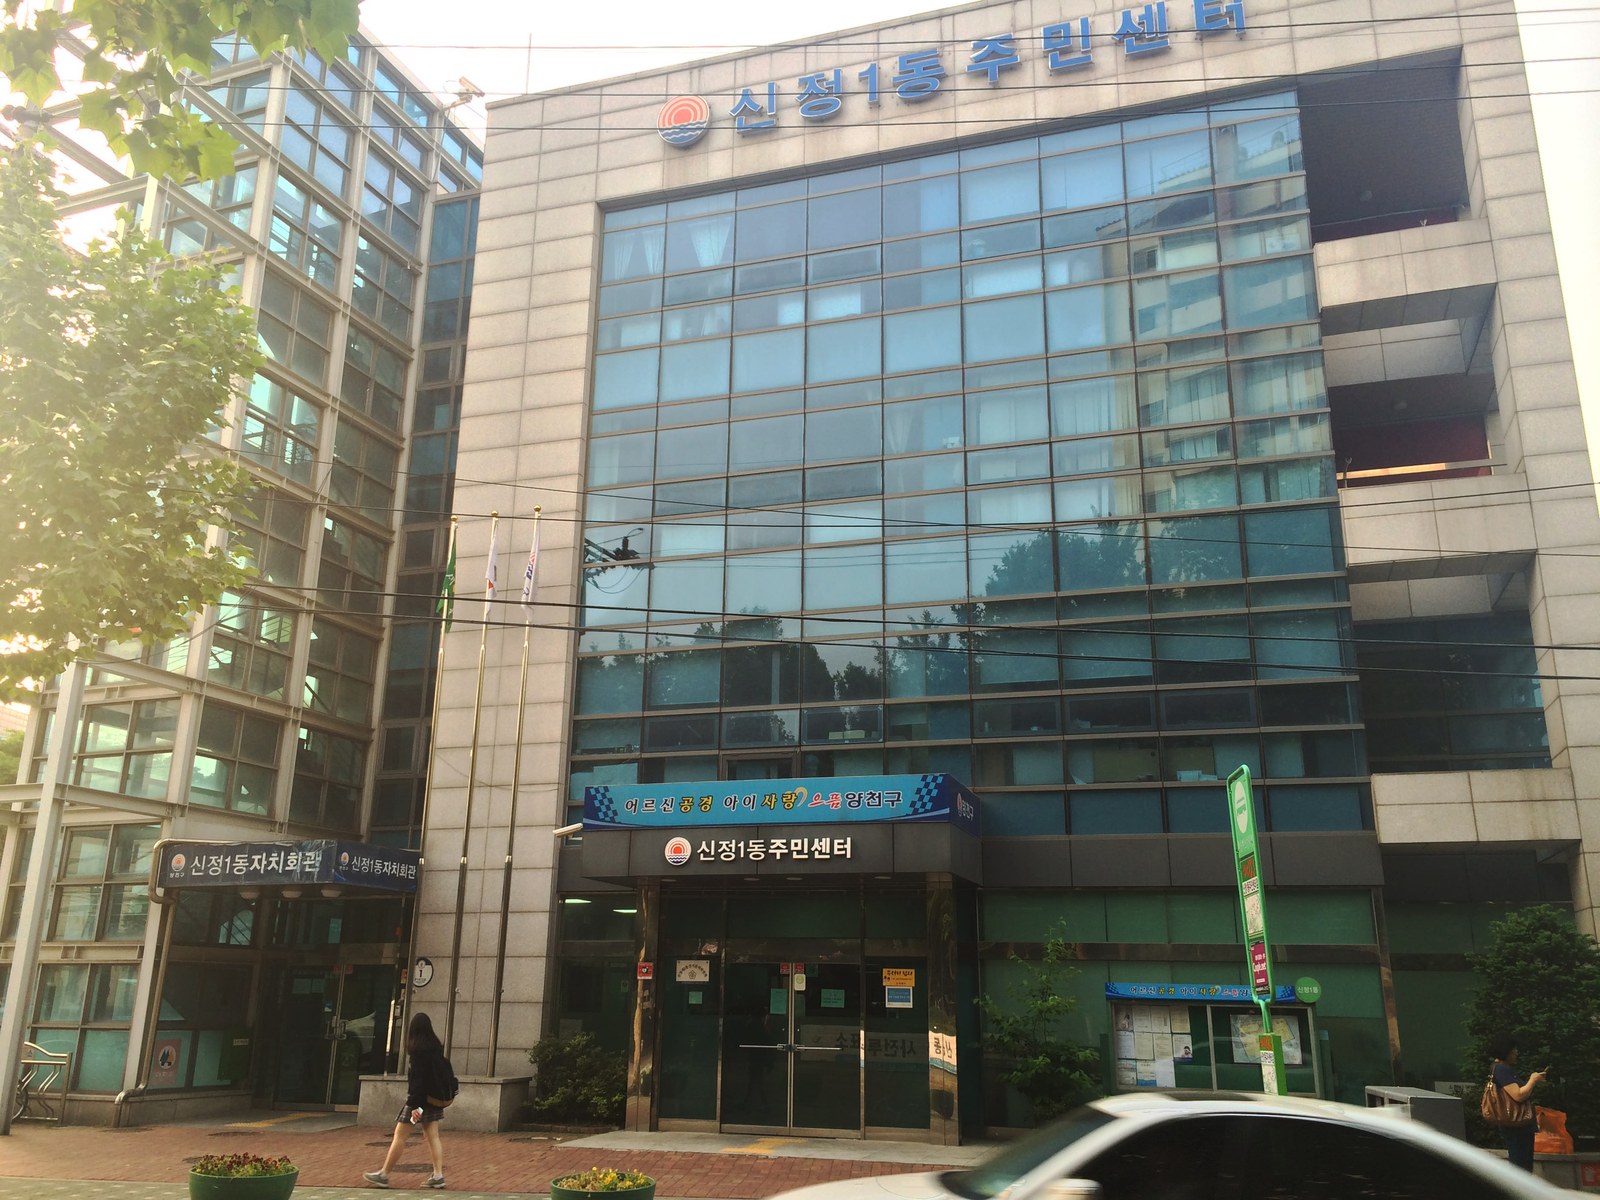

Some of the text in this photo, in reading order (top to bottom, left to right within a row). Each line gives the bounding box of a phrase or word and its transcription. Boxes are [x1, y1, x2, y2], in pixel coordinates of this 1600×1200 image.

[729, 0, 1246, 134] 신정1동주민센터
[697, 837, 852, 861] 신정1동주민센터
[190, 850, 322, 876] 신정1동자치회관
[351, 856, 416, 879] 신정1동자치회관
[1297, 985, 1319, 994] 신정1동
